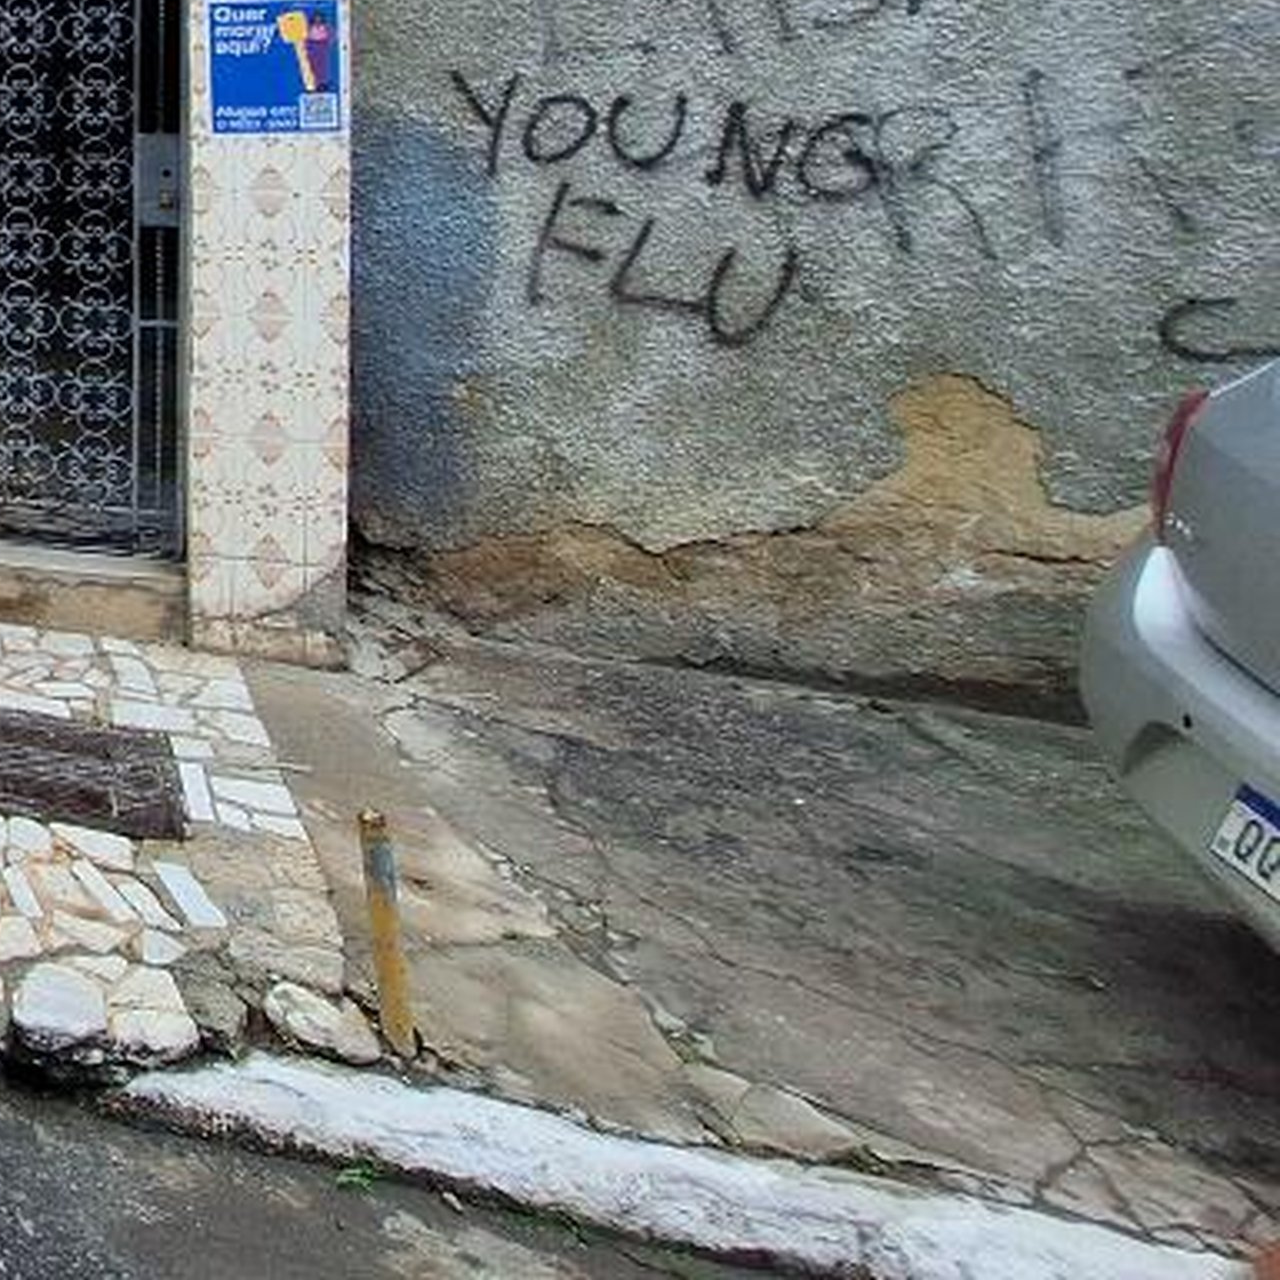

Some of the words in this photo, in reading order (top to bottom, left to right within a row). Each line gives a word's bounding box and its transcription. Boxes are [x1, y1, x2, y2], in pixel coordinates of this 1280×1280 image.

[213, 7, 268, 23] Quer
[214, 24, 278, 38] morar
[214, 37, 272, 57] aqui?
[450, 67, 888, 203] YOUNG
[526, 180, 800, 349] FLU
